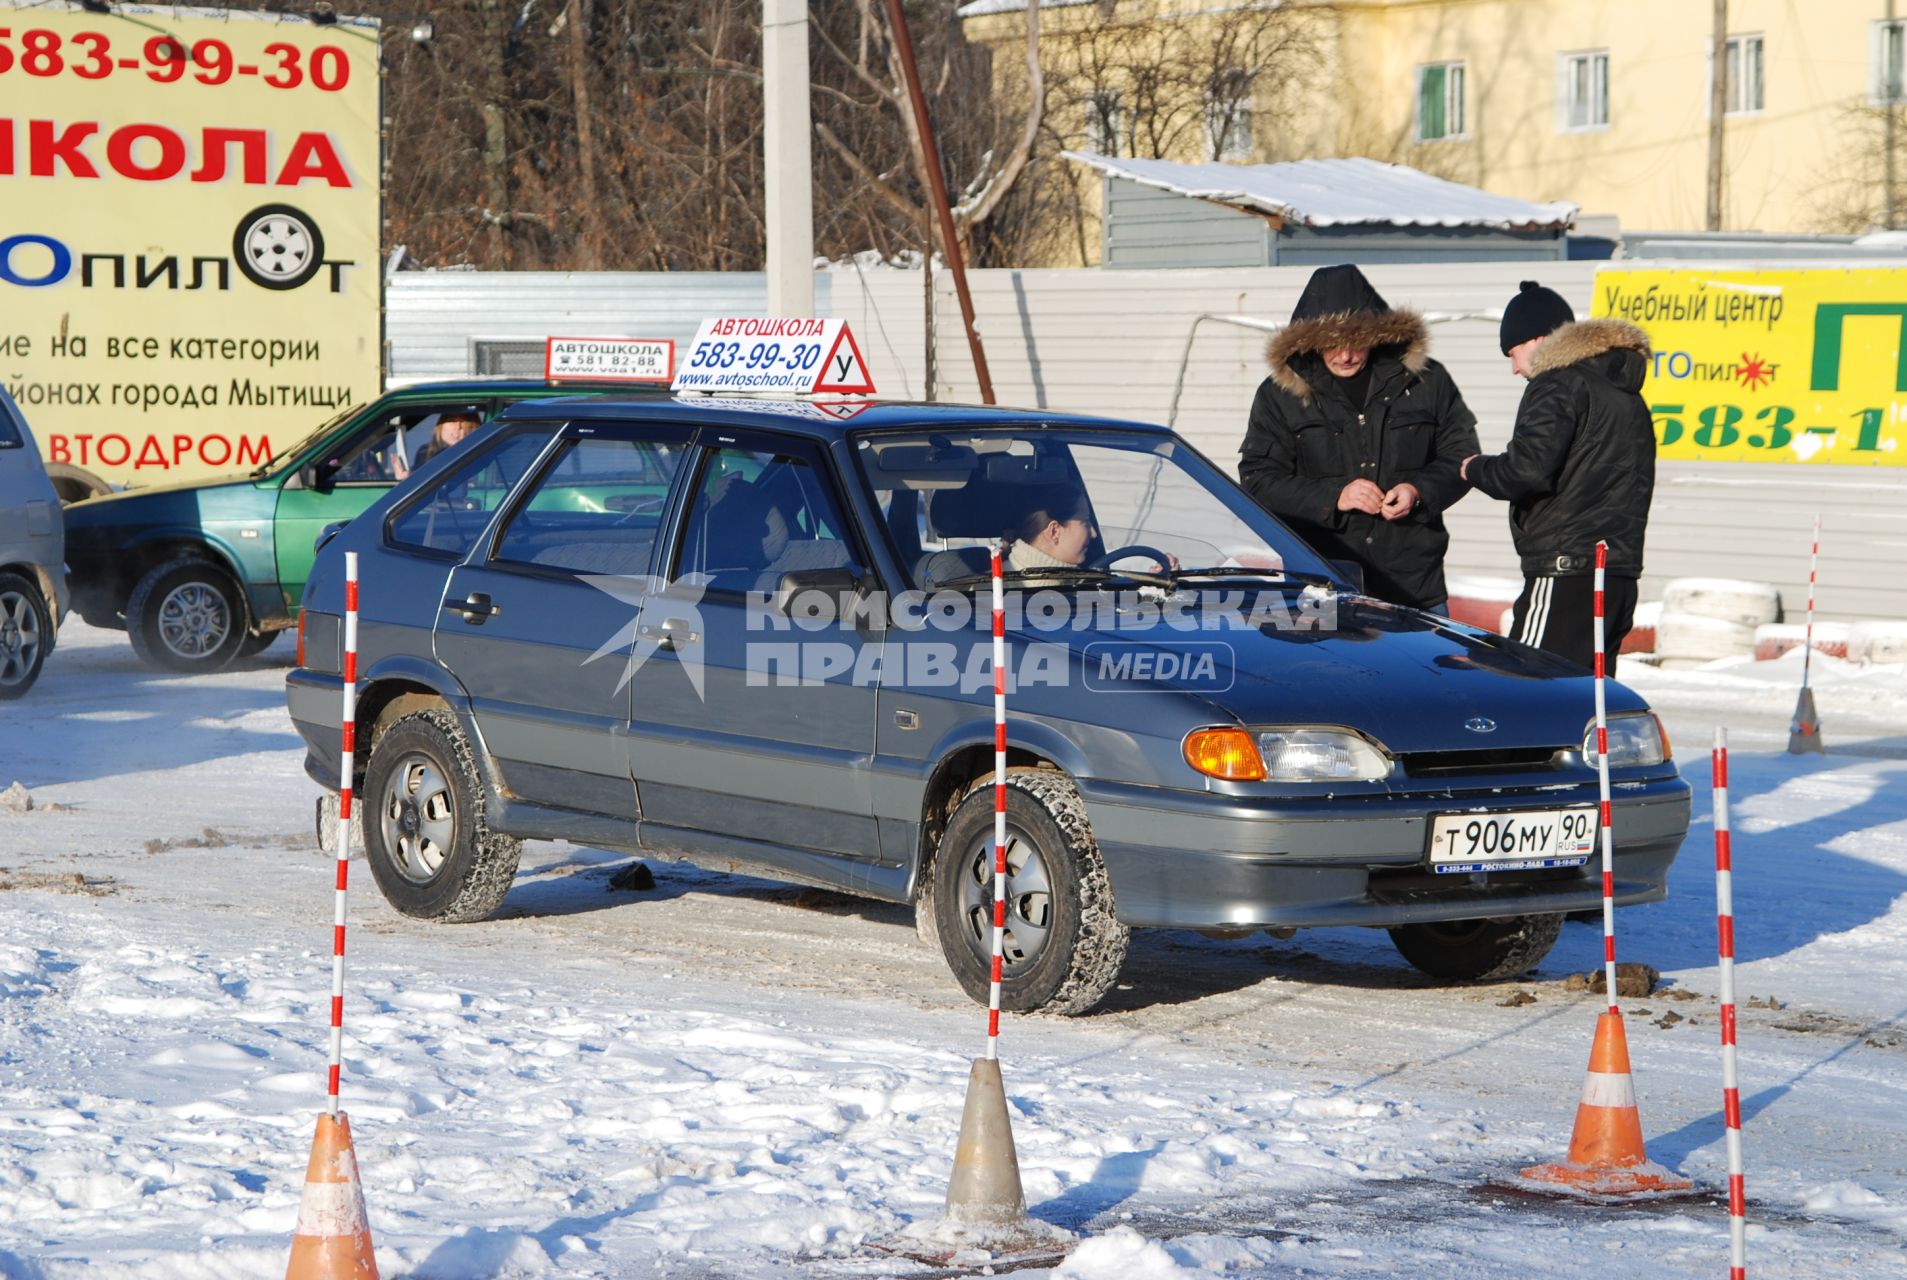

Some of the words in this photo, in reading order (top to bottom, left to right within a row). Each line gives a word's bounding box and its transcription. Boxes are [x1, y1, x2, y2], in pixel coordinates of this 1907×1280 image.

[0, 118, 352, 188] КОЛА
[1605, 284, 1709, 321] Учебный
[1715, 292, 1784, 332] центр
[709, 318, 825, 337] АВТОШКОЛА
[51, 335, 87, 358] на
[107, 336, 160, 359] все
[170, 337, 320, 367] категории
[555, 343, 663, 356] АВТОШКОЛА
[577, 355, 604, 366] 581
[612, 356, 656, 367] 82-88
[690, 342, 822, 370] 583-99-30
[678, 371, 813, 388] www.avtoschool.ru
[835, 354, 853, 382] У
[2, 373, 101, 405] йонах
[112, 383, 218, 413] города
[228, 377, 351, 410] Мытищи
[50, 432, 274, 471] ВТОДРОМ
[1446, 818, 1553, 855] Т906МУ
[1562, 814, 1587, 840] 90
[1558, 841, 1577, 851] RUS
